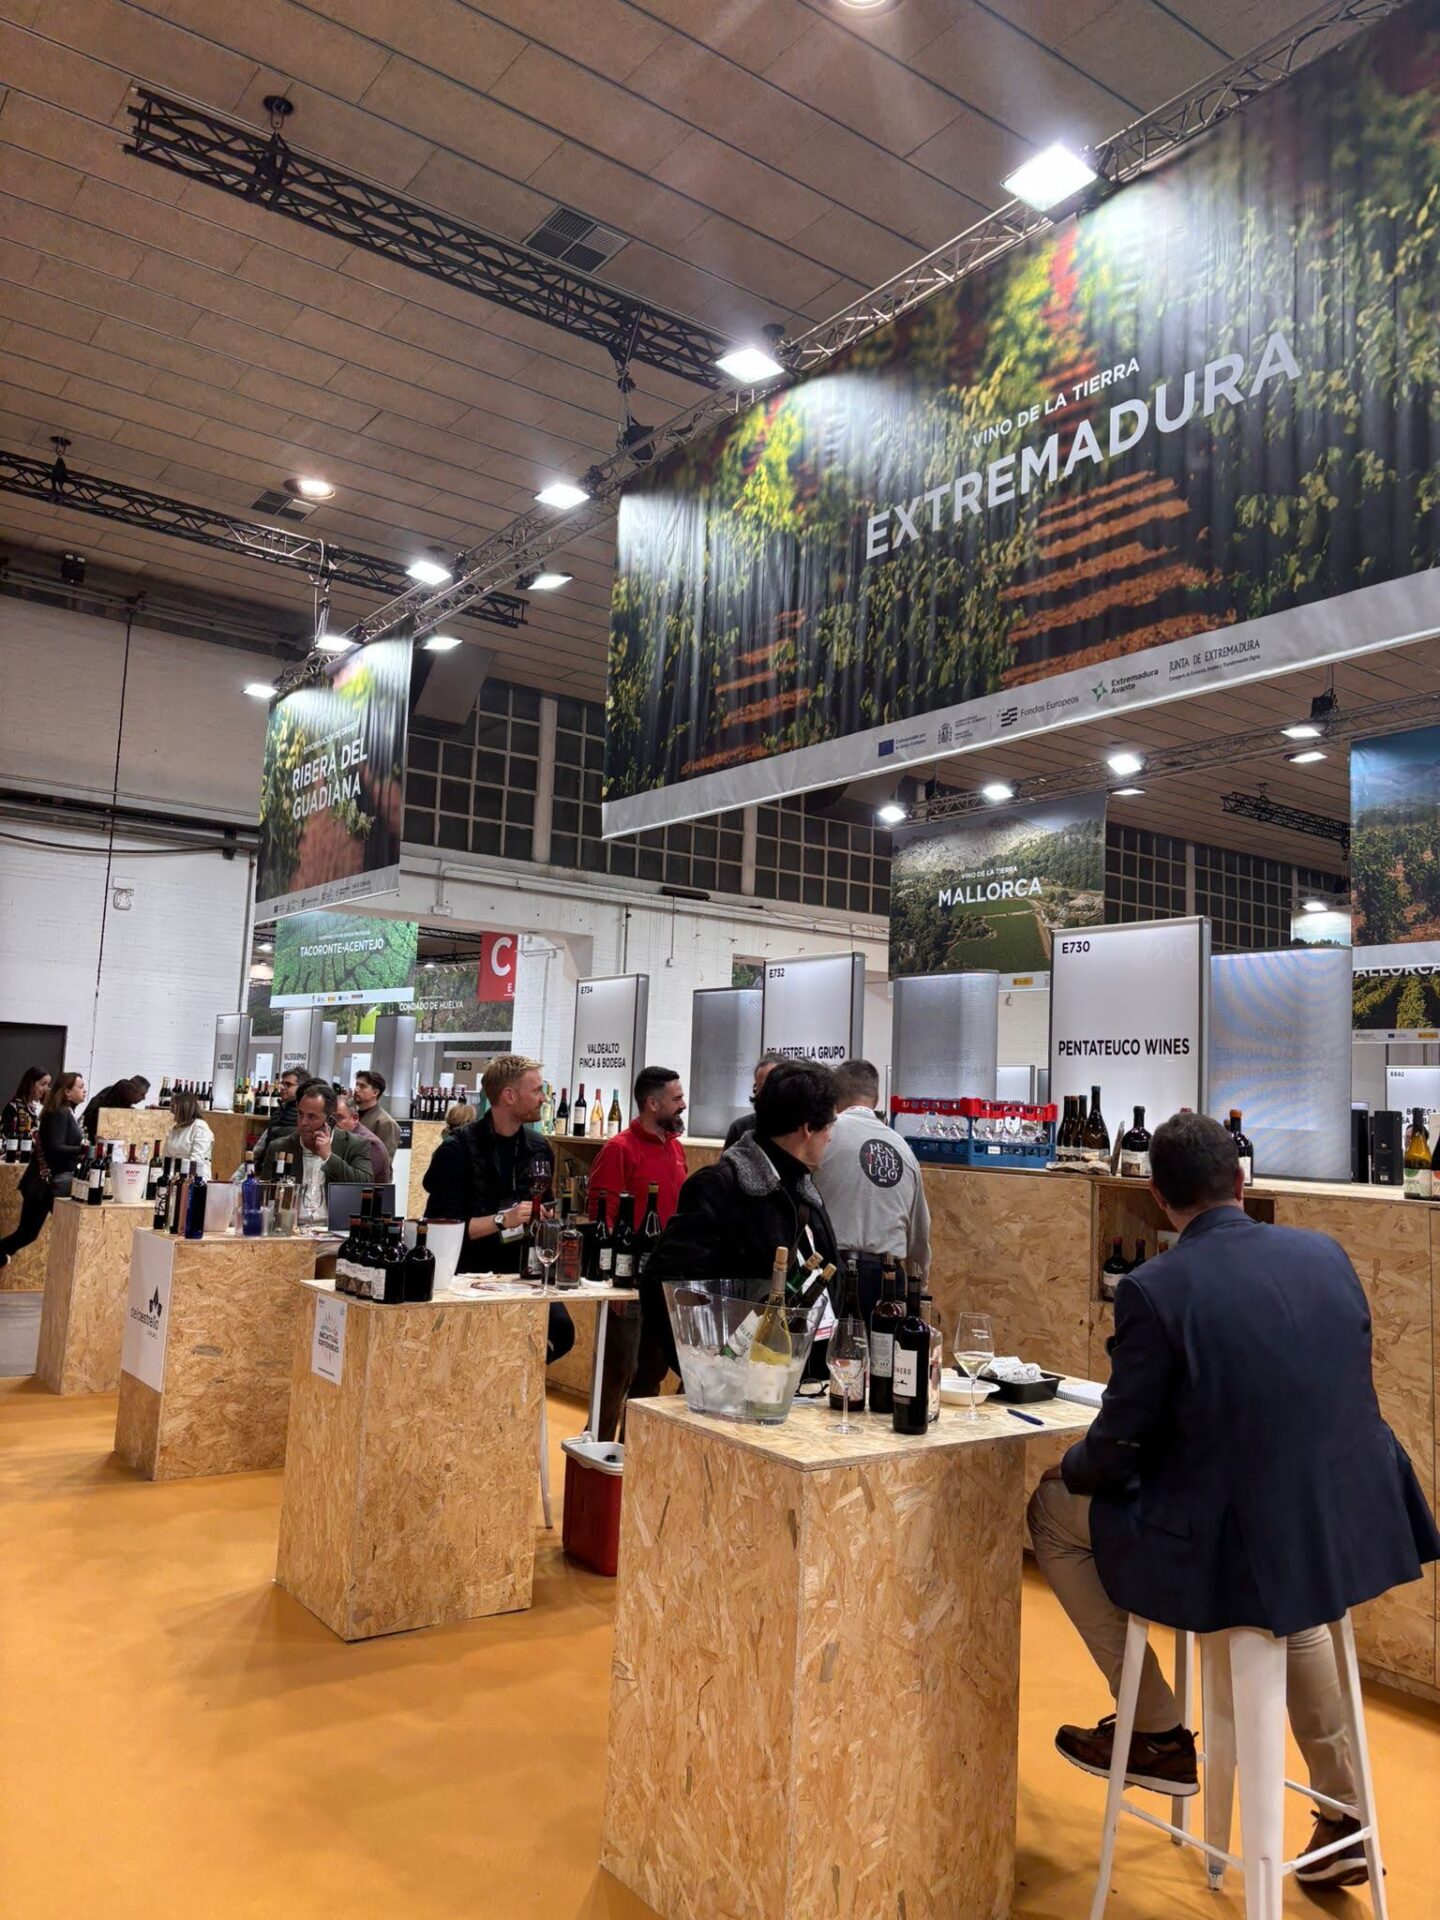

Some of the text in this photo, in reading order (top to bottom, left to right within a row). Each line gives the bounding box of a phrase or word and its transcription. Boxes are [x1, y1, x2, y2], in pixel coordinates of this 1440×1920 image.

[973, 357, 1140, 449] VINO DE LA TIERRA
[865, 331, 1302, 561] EXTREMADURA
[1169, 639, 1261, 673] JUNTA DE EXTREMADURA
[1111, 669, 1159, 687] Extremadura
[1111, 683, 1136, 695] Avante
[1020, 696, 1079, 717] Fondos Europeos
[292, 736, 368, 791] RIBERA DEL
[292, 771, 361, 820] GUADIANA
[995, 865, 1018, 875] TIERRA
[938, 876, 1042, 907] MALLORCA
[300, 937, 385, 957] TACORONTE-ACENTEJO
[491, 936, 513, 976] C
[1062, 940, 1090, 954] E730
[769, 968, 785, 978] E732
[580, 985, 593, 995] E734
[399, 1000, 464, 1012] CONDADO DE HUELVA
[587, 1042, 619, 1054] VALDEALTO
[818, 1045, 845, 1059] GRUPO
[1058, 1037, 1190, 1056] PENTATEUCO WINES
[579, 1057, 596, 1068] FINCA
[602, 1057, 626, 1068] BODEGA
[870, 1143, 895, 1158] PEN
[864, 1151, 900, 1170] TATE
[868, 1164, 898, 1180] UCO
